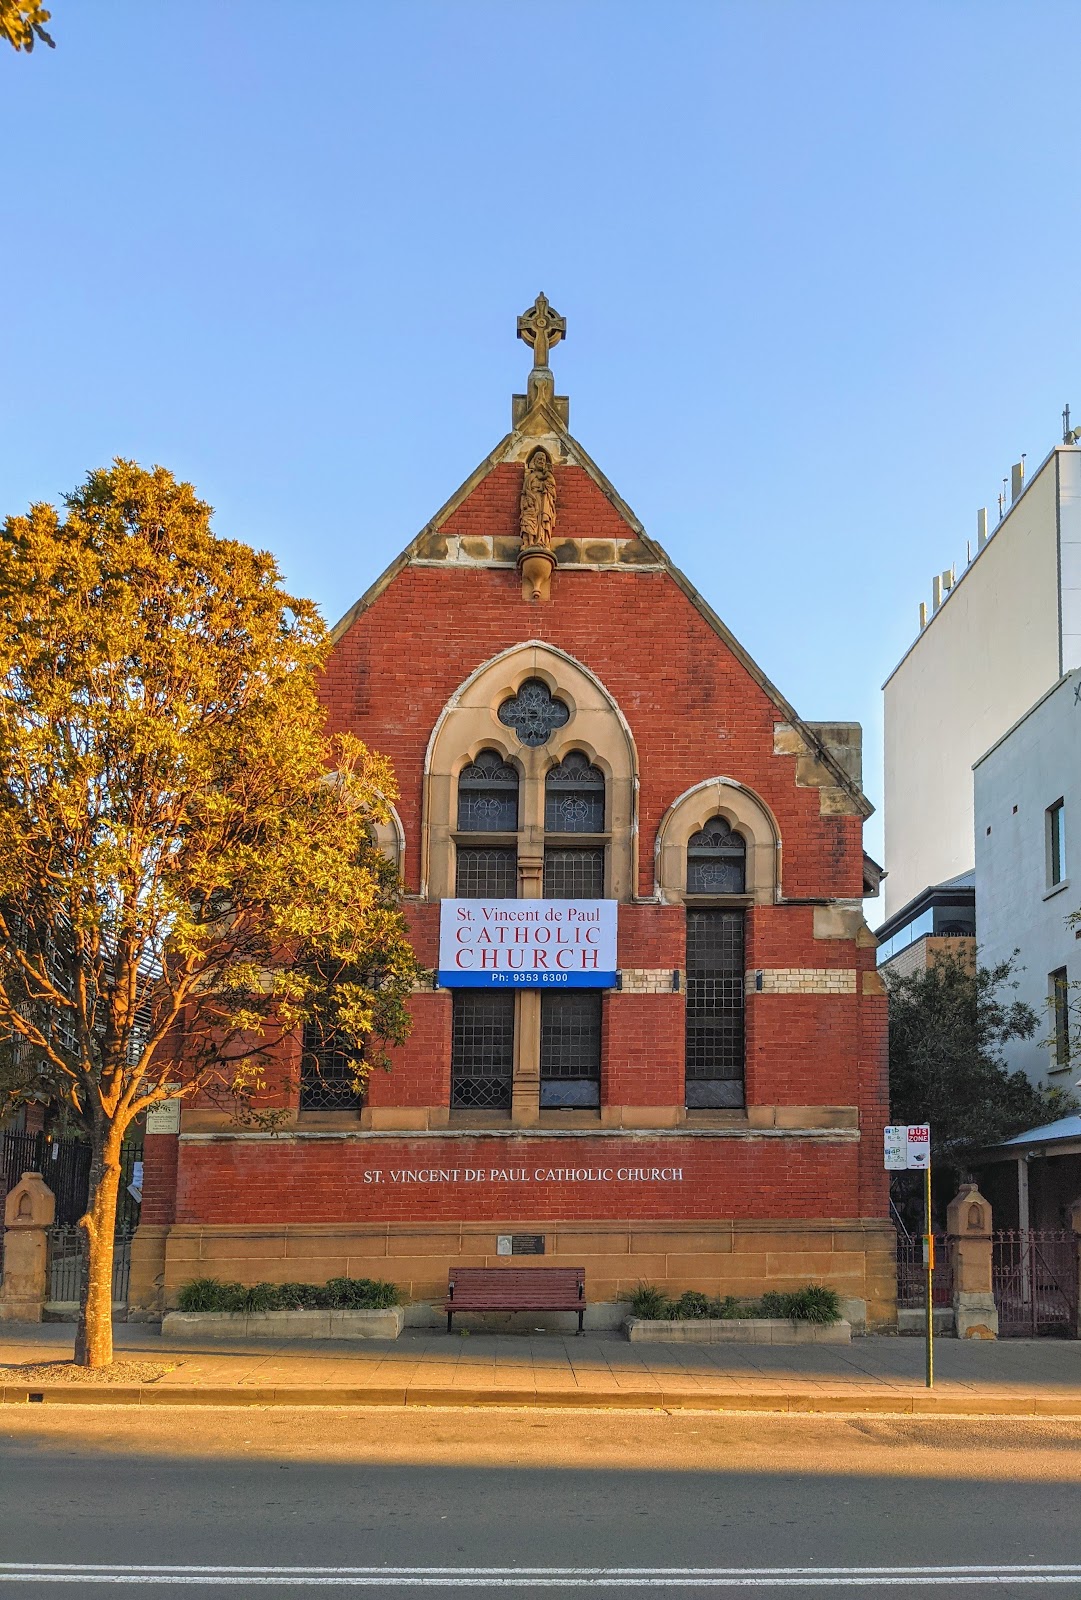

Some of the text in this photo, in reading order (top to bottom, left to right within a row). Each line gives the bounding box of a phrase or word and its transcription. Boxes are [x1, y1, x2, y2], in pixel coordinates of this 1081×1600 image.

[457, 908, 600, 922] St. Vincent de Paul
[456, 926, 601, 944] CATHOLIC
[455, 948, 600, 969] CHURCH
[491, 973, 568, 982] Ph: 9353 6300
[363, 1168, 683, 1183] ST. VINCENT DE PAUL CATHOLIC CHURCH
